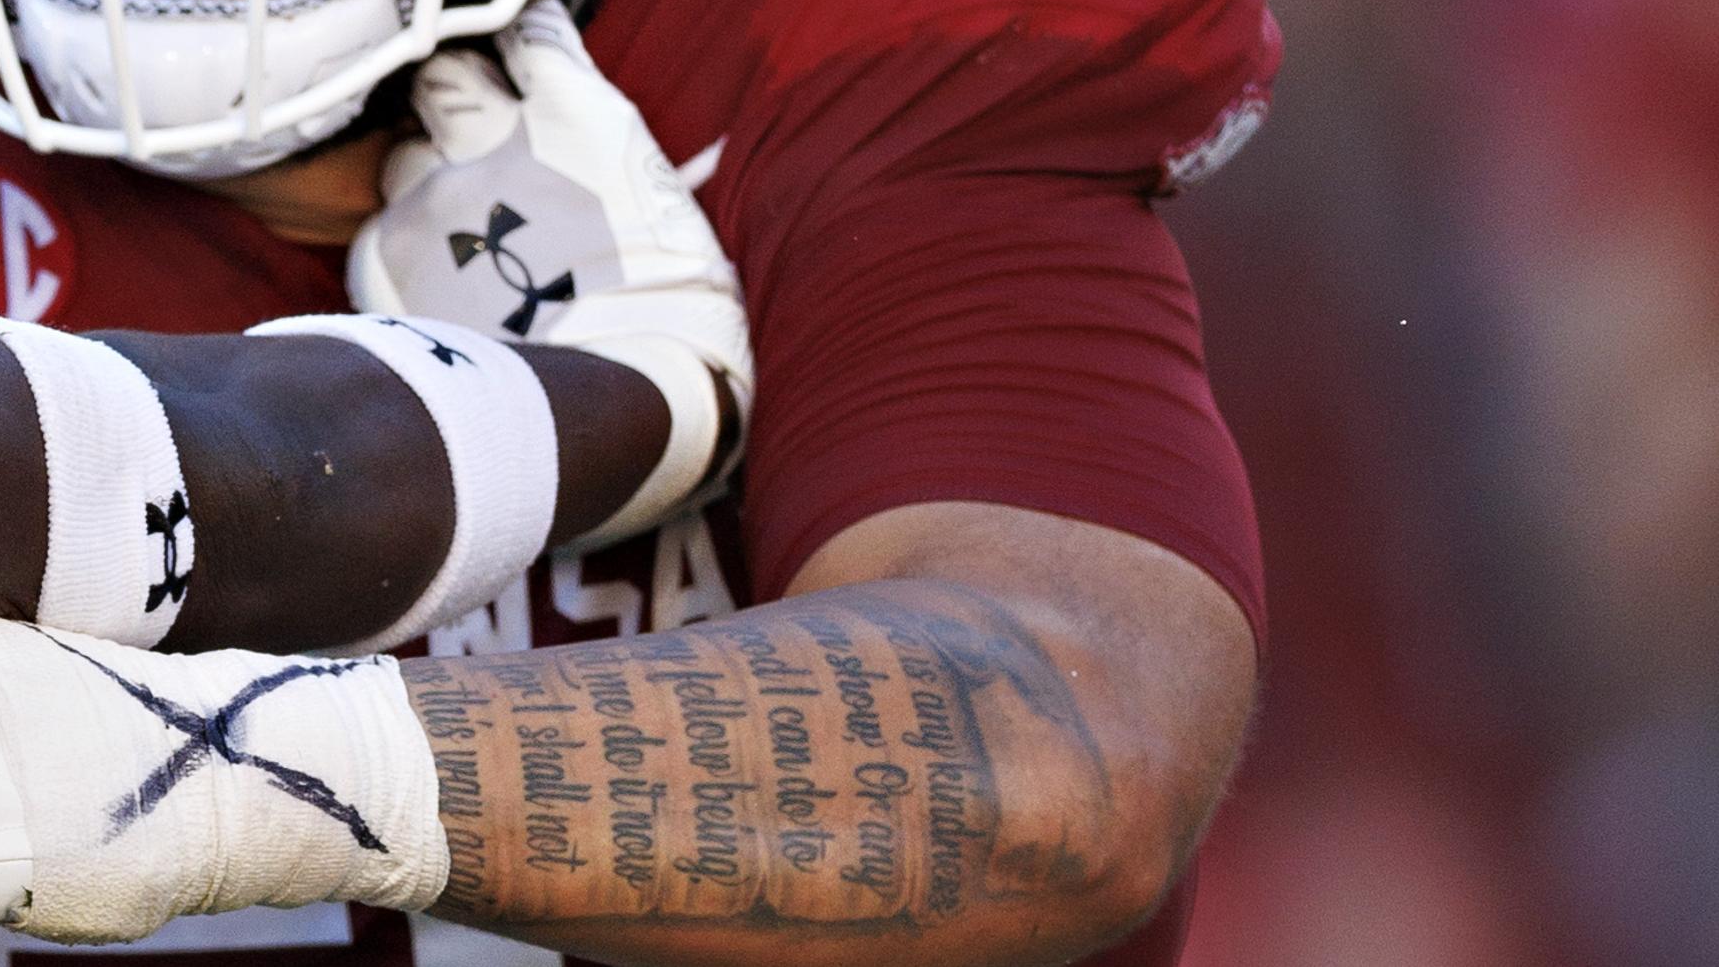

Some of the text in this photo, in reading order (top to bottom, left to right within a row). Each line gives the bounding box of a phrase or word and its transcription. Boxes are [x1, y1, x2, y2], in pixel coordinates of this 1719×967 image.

[417, 680, 494, 742] this
[582, 672, 636, 719] me
[645, 670, 749, 777] fellow
[901, 691, 959, 751] any
[516, 723, 595, 809] shall
[601, 723, 668, 772] do
[768, 706, 818, 771] can
[608, 778, 668, 814] it
[776, 777, 838, 828] do
[855, 761, 914, 816] Or
[525, 813, 589, 873] not
[610, 811, 654, 891] now
[672, 782, 760, 886] being.
[779, 830, 836, 874] to
[840, 822, 895, 898] any
